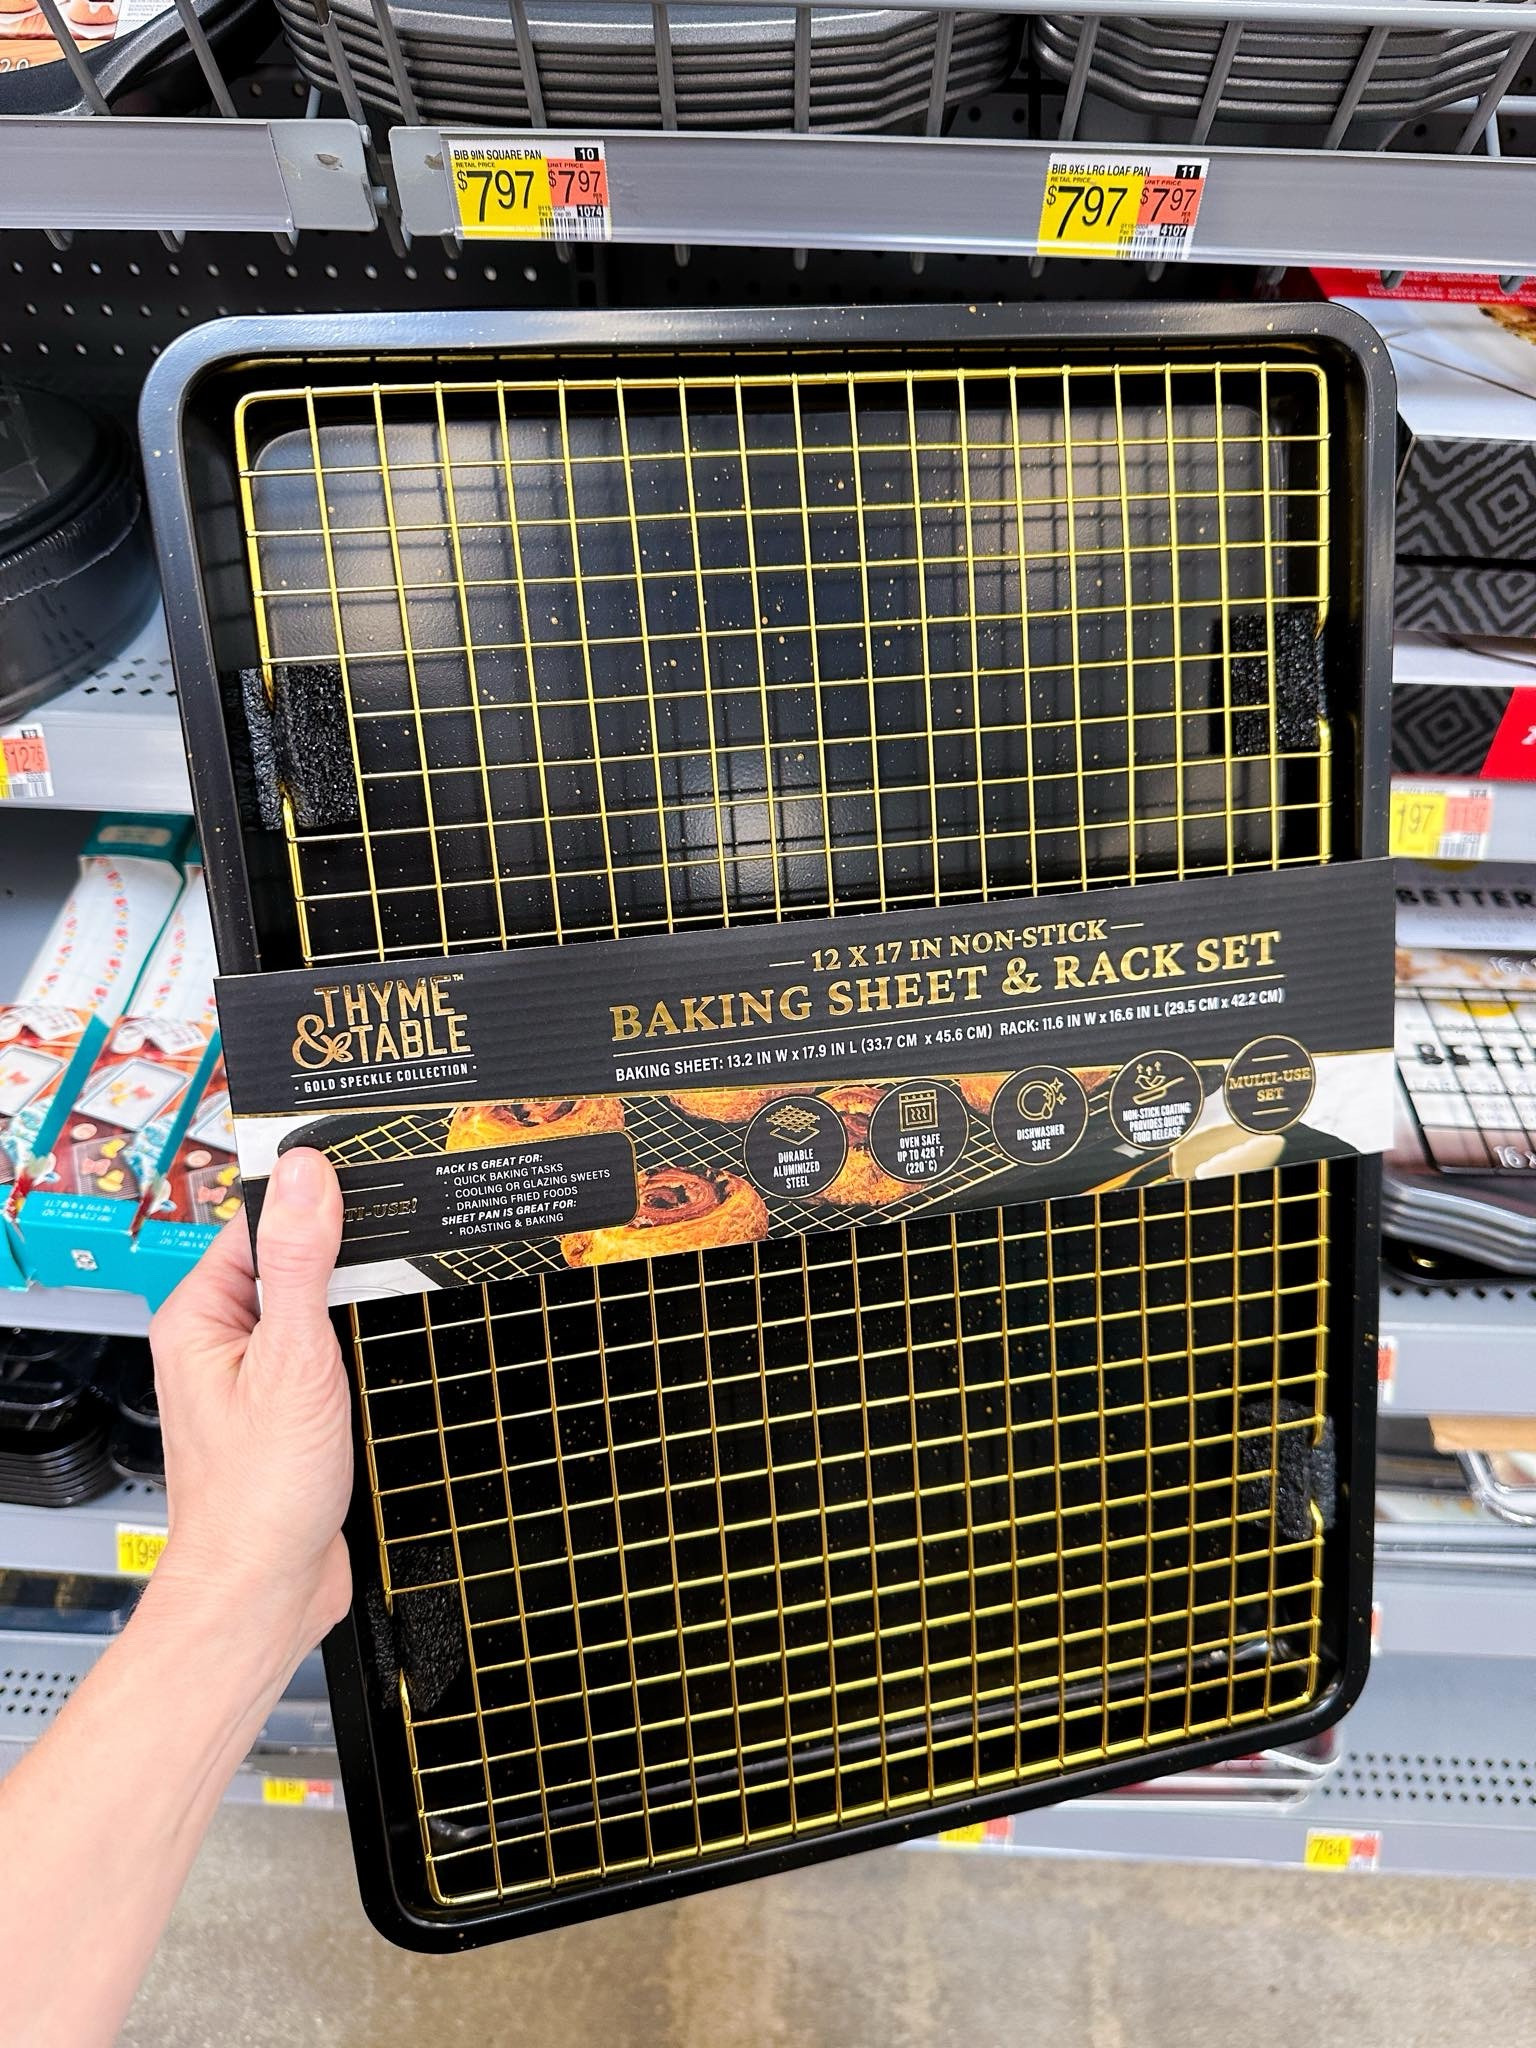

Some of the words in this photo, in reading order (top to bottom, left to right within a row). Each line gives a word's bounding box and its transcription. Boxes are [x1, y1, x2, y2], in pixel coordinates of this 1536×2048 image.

[454, 150, 469, 160] BIB
[471, 150, 484, 160] 9IN
[486, 150, 522, 160] SQUARE
[524, 150, 542, 160] PAN
[580, 149, 594, 159] 10
[1052, 164, 1067, 175] BIB
[1068, 164, 1085, 175] 9X5
[1086, 165, 1105, 176] LRG
[1107, 165, 1132, 176] LOAF
[1132, 166, 1152, 177] PAN
[1181, 166, 1195, 178] 11
[578, 206, 603, 217] 1074
[1161, 225, 1187, 237] 4107
[811, 948, 842, 972] 12
[848, 945, 869, 968] X
[875, 942, 903, 965] 17
[909, 937, 943, 961] IN
[950, 919, 1108, 957] NON-STICK
[609, 985, 813, 1042] BAKING
[829, 966, 987, 1016] SHEET
[1001, 956, 1042, 996] &
[1053, 942, 1186, 990] RACK
[1196, 930, 1282, 974] SET
[314, 974, 456, 1028] THYME
[1000, 1018, 1039, 1036] RACK:
[1041, 1015, 1064, 1031] 11.6
[1067, 1013, 1081, 1028] IN
[1084, 1011, 1097, 1025] W
[1109, 1007, 1134, 1023] 16.6
[1137, 1005, 1151, 1020] IN
[1153, 1003, 1163, 1017] L
[1164, 999, 1197, 1018] (29.5
[1199, 996, 1219, 1012] CM
[1230, 991, 1258, 1008] 42.2
[1258, 987, 1286, 1005] CM)
[292, 1014, 353, 1069] &
[350, 1014, 472, 1064] TABLE
[615, 1063, 670, 1082] BAKING
[674, 1057, 724, 1075] SHEET:
[727, 1052, 753, 1069] 13.2
[757, 1050, 772, 1065] IN
[775, 1048, 788, 1063] W
[802, 1044, 827, 1060] 17.9
[831, 1041, 845, 1056] IN
[850, 1040, 858, 1054] L
[861, 1037, 893, 1055] (33.7
[896, 1033, 918, 1048] CM
[935, 1028, 963, 1044] 45.6
[966, 1023, 993, 1040] CM)
[1415, 1043, 1536, 1068] BETT
[304, 1078, 336, 1093] GOLD
[340, 1071, 393, 1089] SPECKLE
[396, 1063, 468, 1082] COLLECTION
[1229, 1066, 1313, 1090] MULTI-USE
[1256, 1086, 1285, 1103] SET
[1122, 1106, 1161, 1122] NON-STICK
[1160, 1101, 1192, 1117] COATING
[1016, 1123, 1065, 1142] DISHWASHER
[1129, 1117, 1164, 1133] PROVIDES
[1163, 1114, 1187, 1128] QUICK
[899, 1135, 920, 1149] OVEN
[921, 1132, 941, 1147] SAFE
[1133, 1130, 1152, 1144] FOOD
[1152, 1126, 1182, 1142] RELEASE
[897, 1150, 908, 1163] UP
[908, 1148, 920, 1161] TO
[1031, 1140, 1052, 1152] SAFE
[435, 1163, 466, 1176] RACK
[468, 1161, 479, 1172] IS
[481, 1156, 517, 1170] GREAT
[518, 1153, 543, 1165] FOR:
[778, 1148, 814, 1165] DURABLE
[453, 1173, 487, 1187] QUICK
[489, 1168, 529, 1182] BAKING
[531, 1162, 564, 1176] TASKS
[773, 1160, 821, 1178] ALUMINIZED
[455, 1183, 503, 1199] COOLING
[505, 1181, 521, 1192] OR
[523, 1174, 568, 1189] GLAZING
[570, 1169, 611, 1183] SWEETS
[785, 1177, 810, 1190] STEEL
[456, 1195, 508, 1211] DRAINING
[510, 1191, 541, 1204] FRIED
[543, 1186, 579, 1199] FOODS
[441, 1212, 476, 1226] SHEET
[478, 1209, 501, 1221] PAN
[503, 1207, 514, 1217] IS
[516, 1202, 551, 1215] GREAT
[552, 1199, 577, 1210] FOR:
[459, 1220, 512, 1236] ROASTING
[514, 1218, 523, 1228] &
[525, 1212, 564, 1226] BAKING
